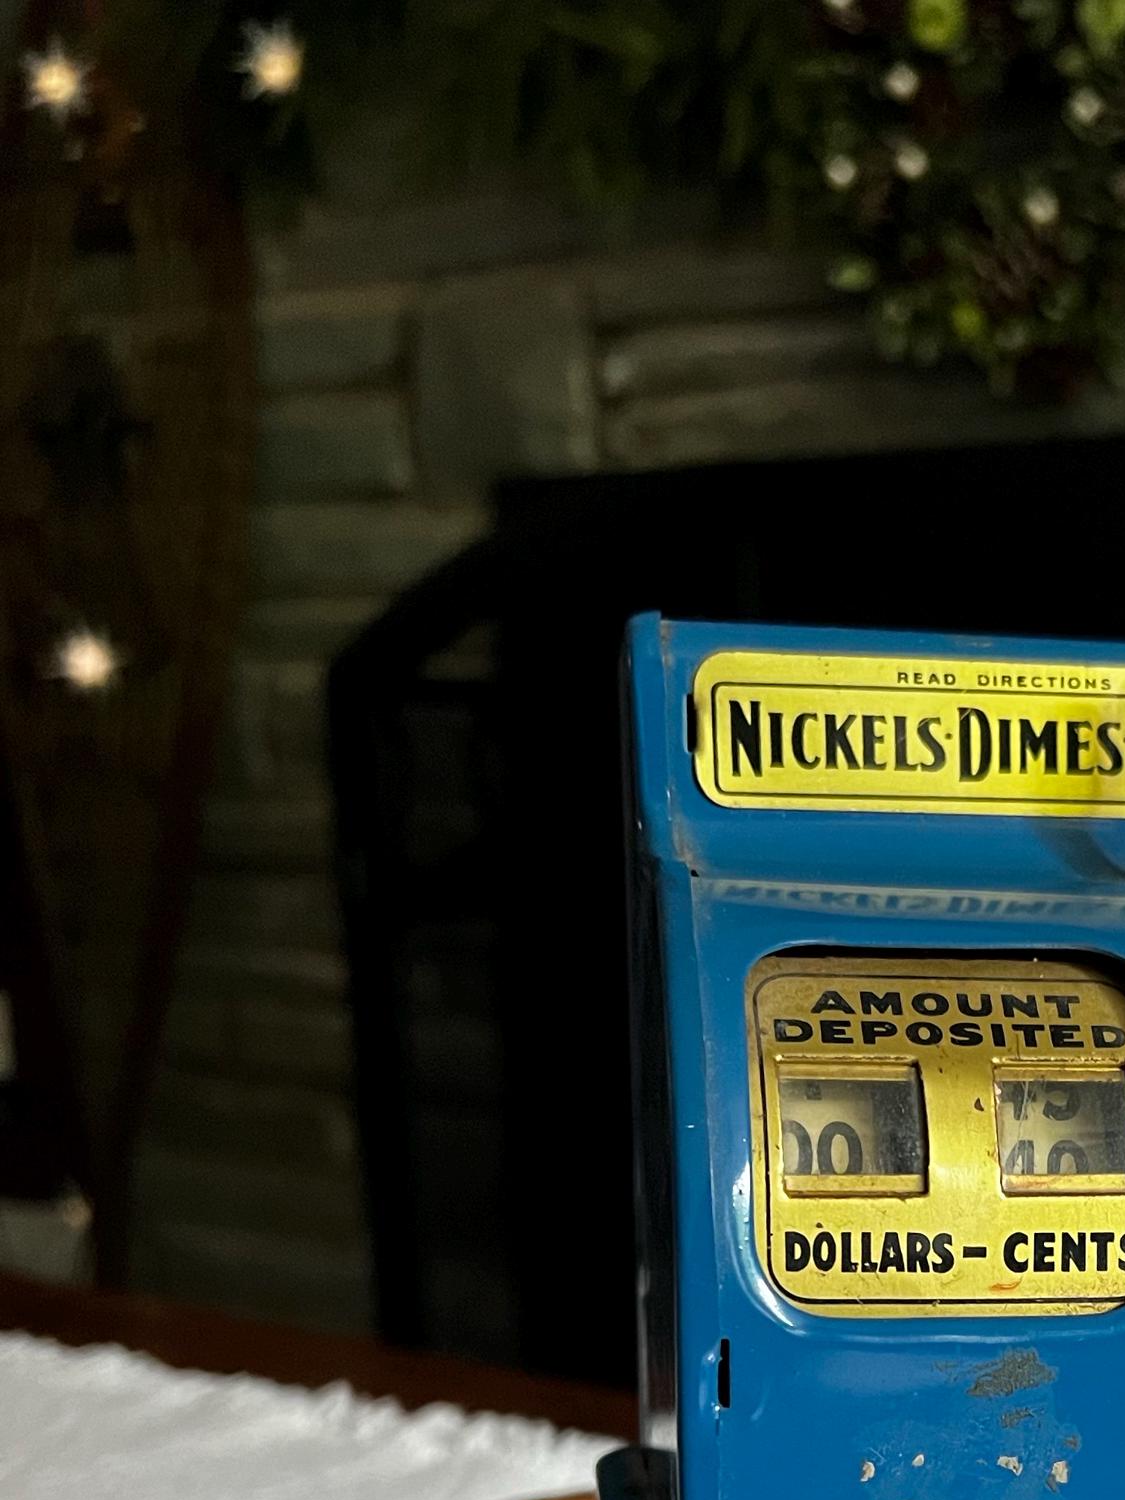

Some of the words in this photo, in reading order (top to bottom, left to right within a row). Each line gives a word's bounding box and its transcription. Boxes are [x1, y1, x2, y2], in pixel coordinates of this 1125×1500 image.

[897, 671, 957, 686] READ
[977, 674, 1112, 691] DIRECTIONS
[810, 991, 1080, 1018] AMOUNT
[785, 1231, 955, 1273] DOLLARS
